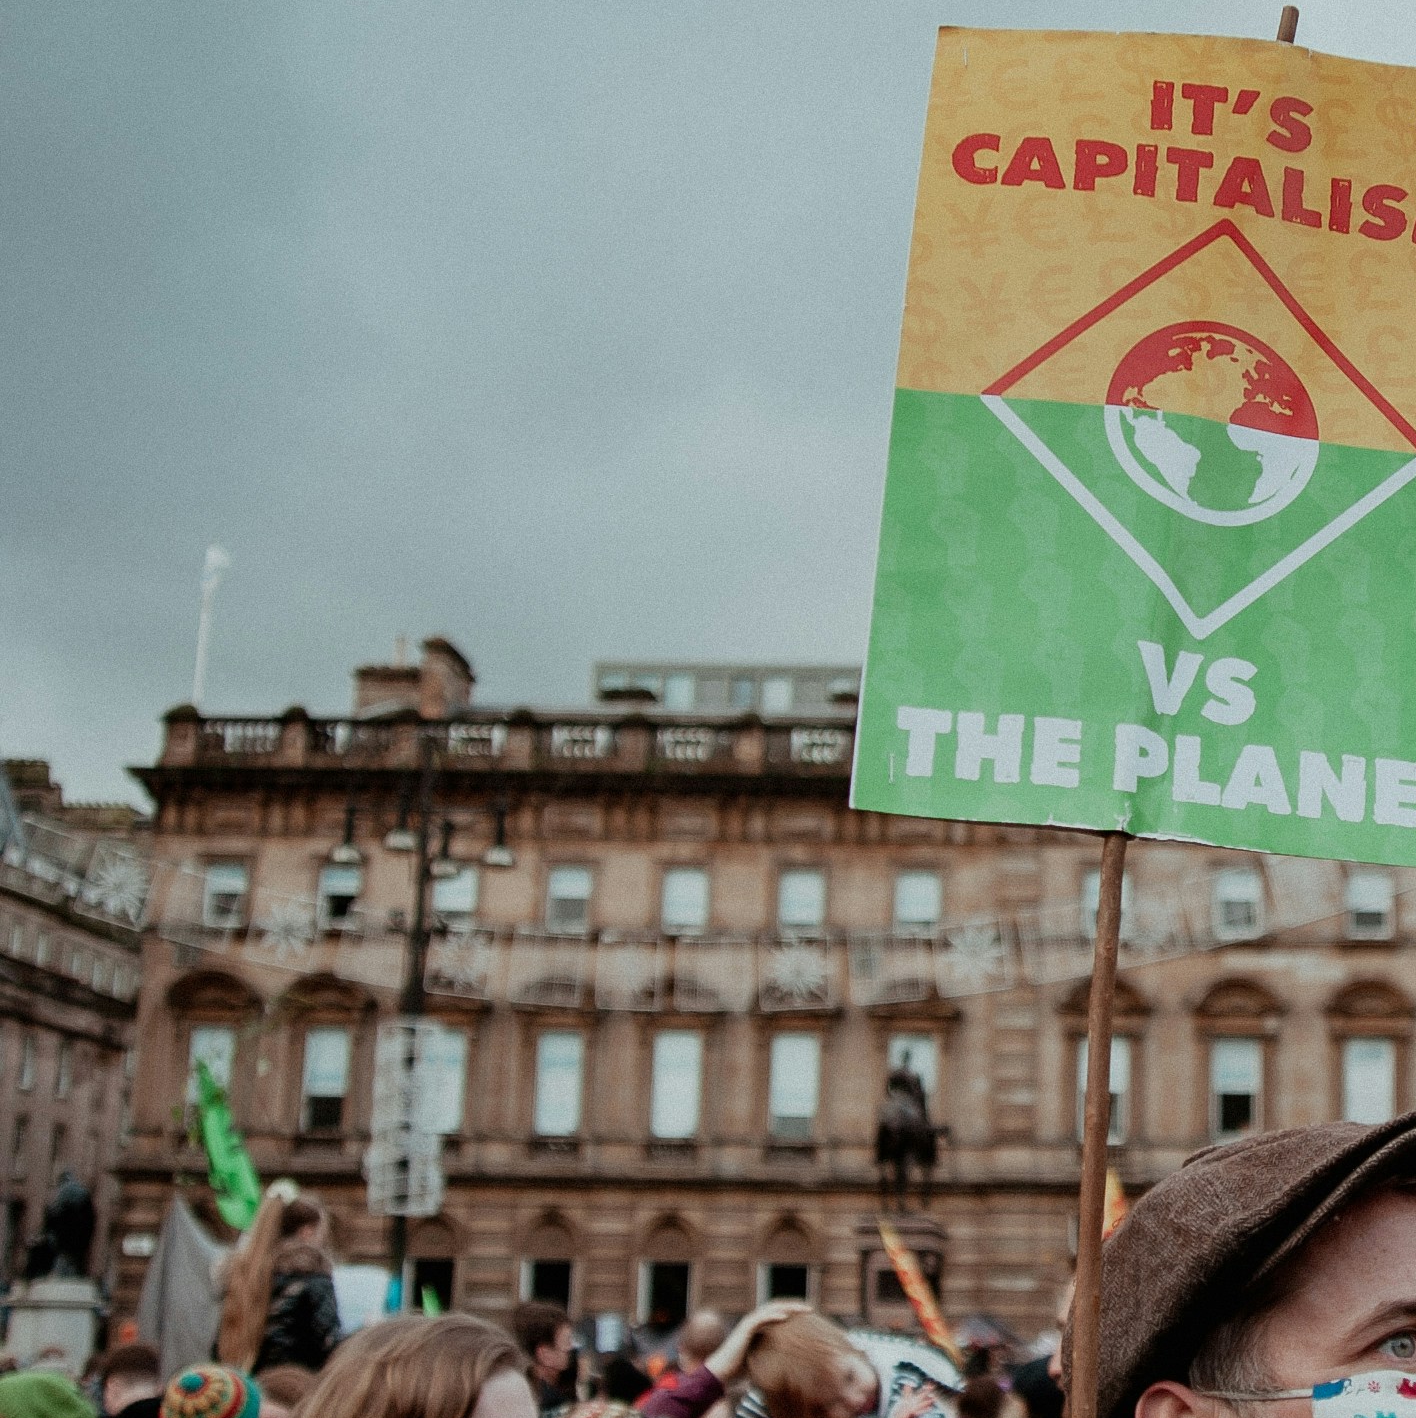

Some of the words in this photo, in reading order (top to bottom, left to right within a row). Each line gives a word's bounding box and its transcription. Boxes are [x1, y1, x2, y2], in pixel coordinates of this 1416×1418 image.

[1150, 81, 1314, 152] IT'S
[1137, 640, 1258, 726] VS
[897, 705, 1082, 789] THE
